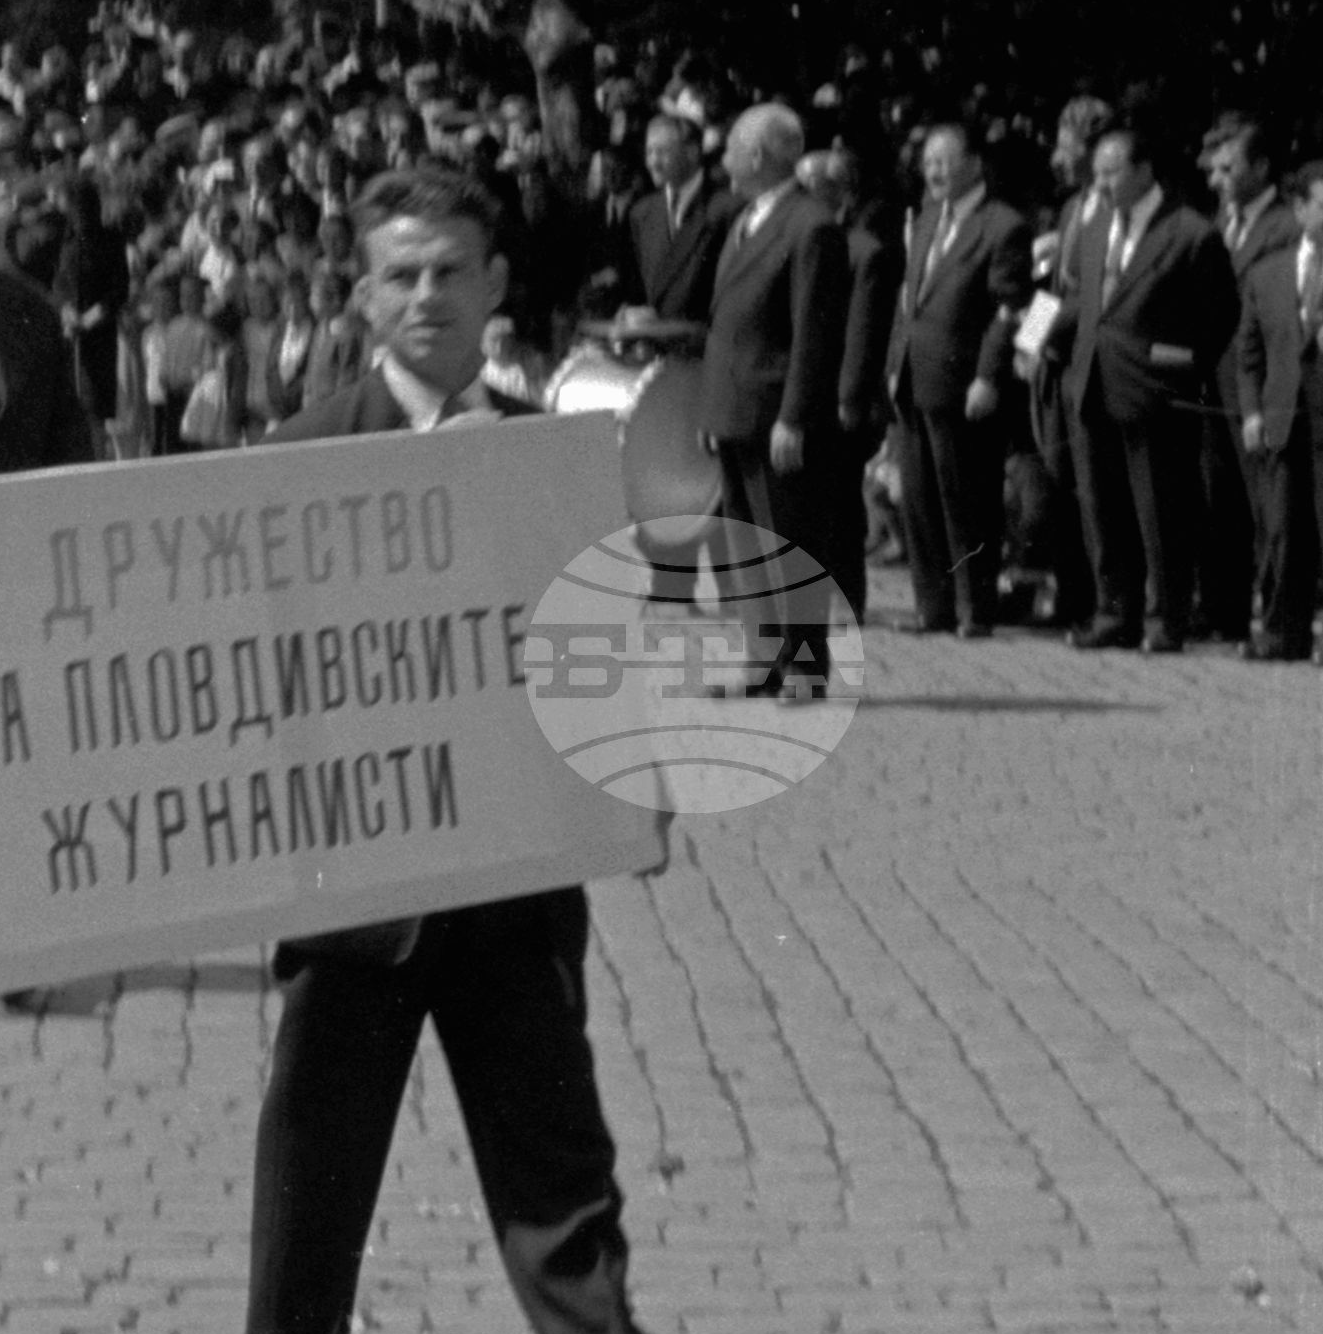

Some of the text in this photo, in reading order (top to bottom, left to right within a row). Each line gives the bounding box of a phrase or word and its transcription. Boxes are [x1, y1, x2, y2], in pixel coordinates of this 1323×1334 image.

[42, 483, 455, 643] ДРУЖЕСТВО
[64, 602, 530, 755] ПЛОВДИВСКИТЕ
[41, 739, 460, 896] ЖУРНАЛИСТИ
